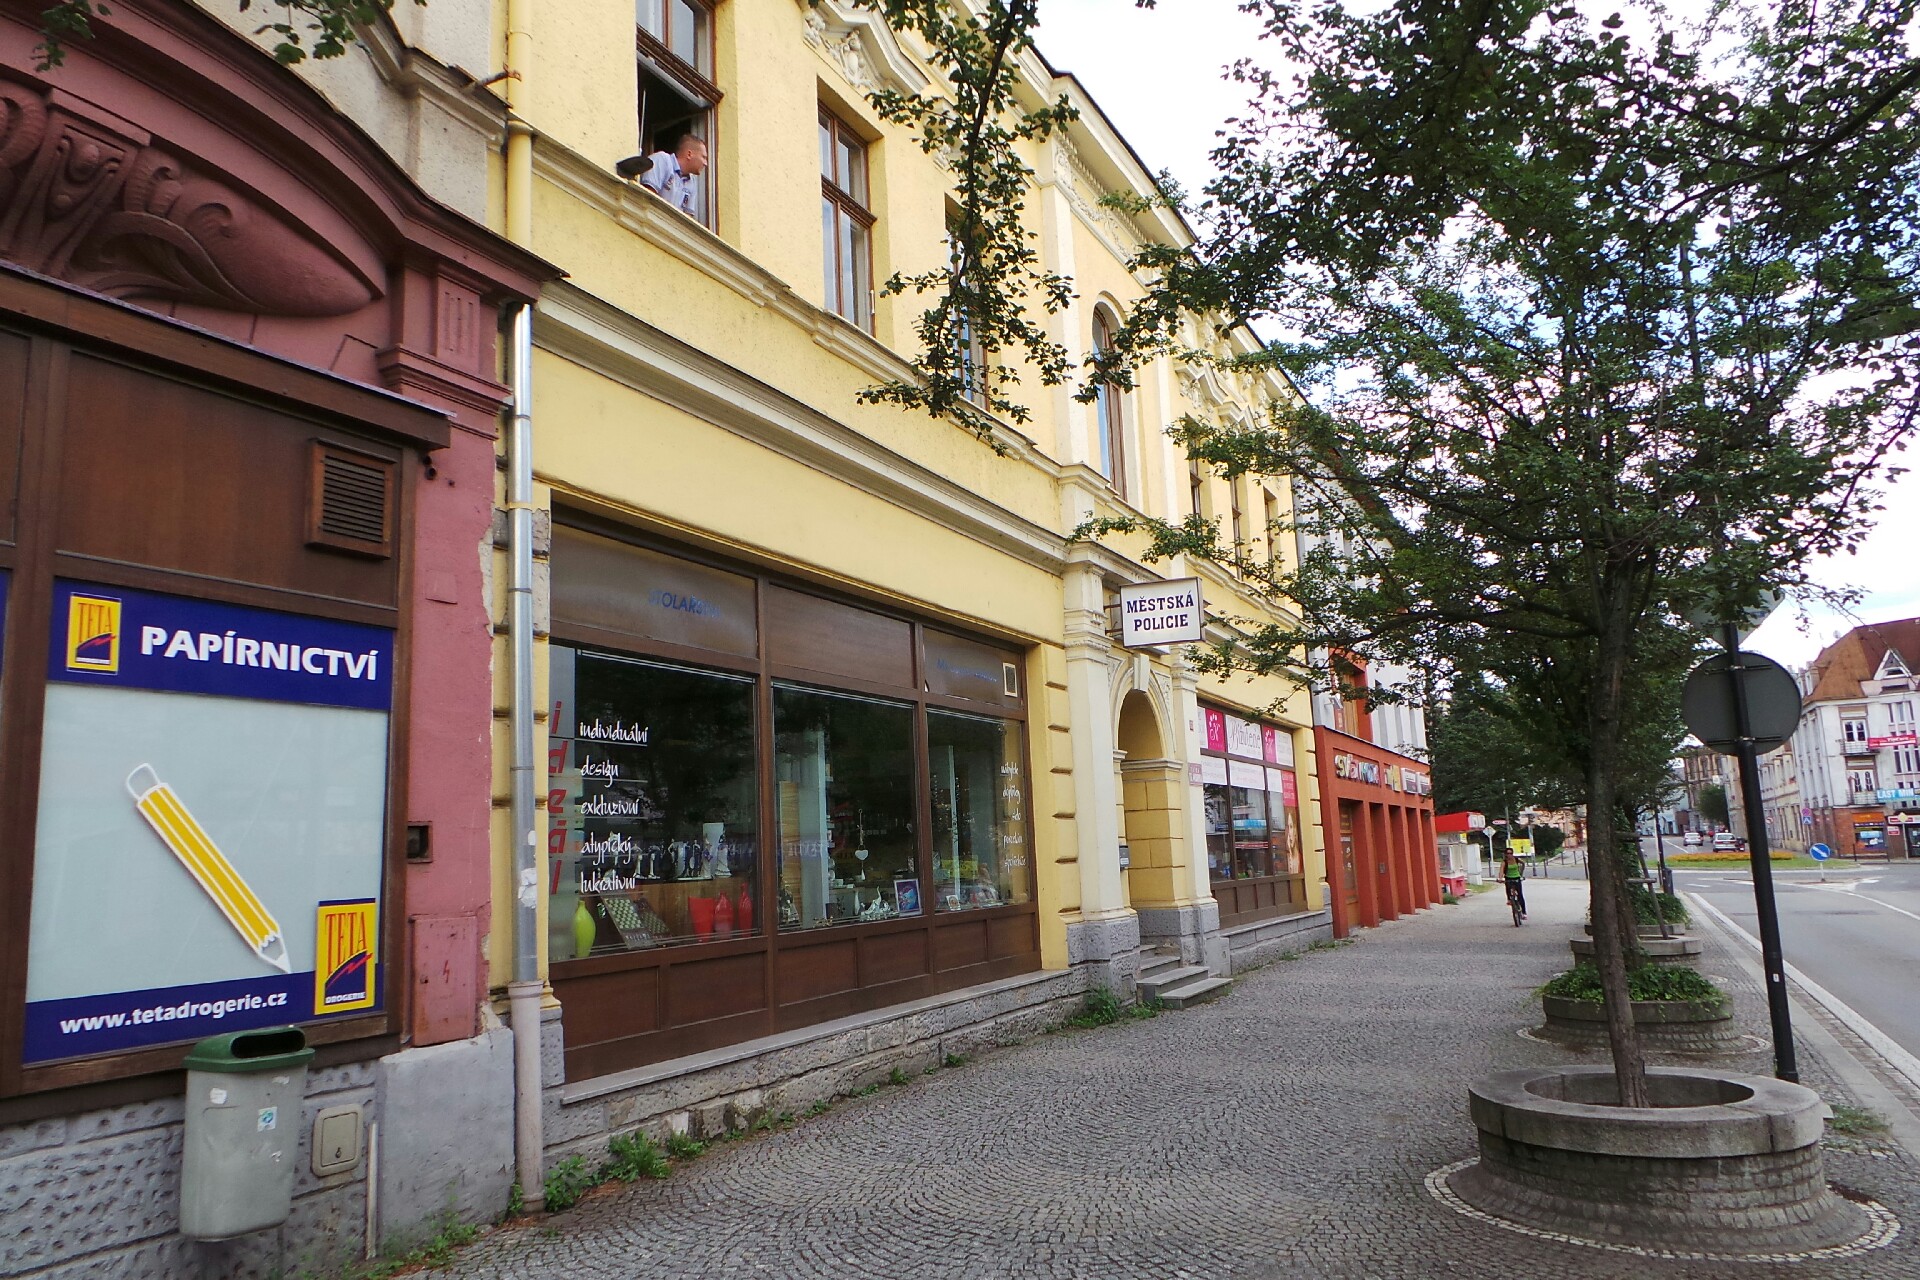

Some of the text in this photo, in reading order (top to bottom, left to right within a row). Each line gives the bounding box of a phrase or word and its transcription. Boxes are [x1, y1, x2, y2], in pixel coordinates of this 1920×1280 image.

[1126, 590, 1194, 613] MĚSTSKÁ
[1134, 614, 1189, 632] POLICIE
[141, 625, 378, 681] PAPÍRNICTVÍ
[580, 718, 649, 743] individuální
[581, 755, 619, 788] design
[581, 794, 640, 815] exkluzivní
[581, 832, 632, 866] atypický
[325, 911, 368, 977] TETA
[60, 990, 288, 1034] www.tetadrogerie.cz
